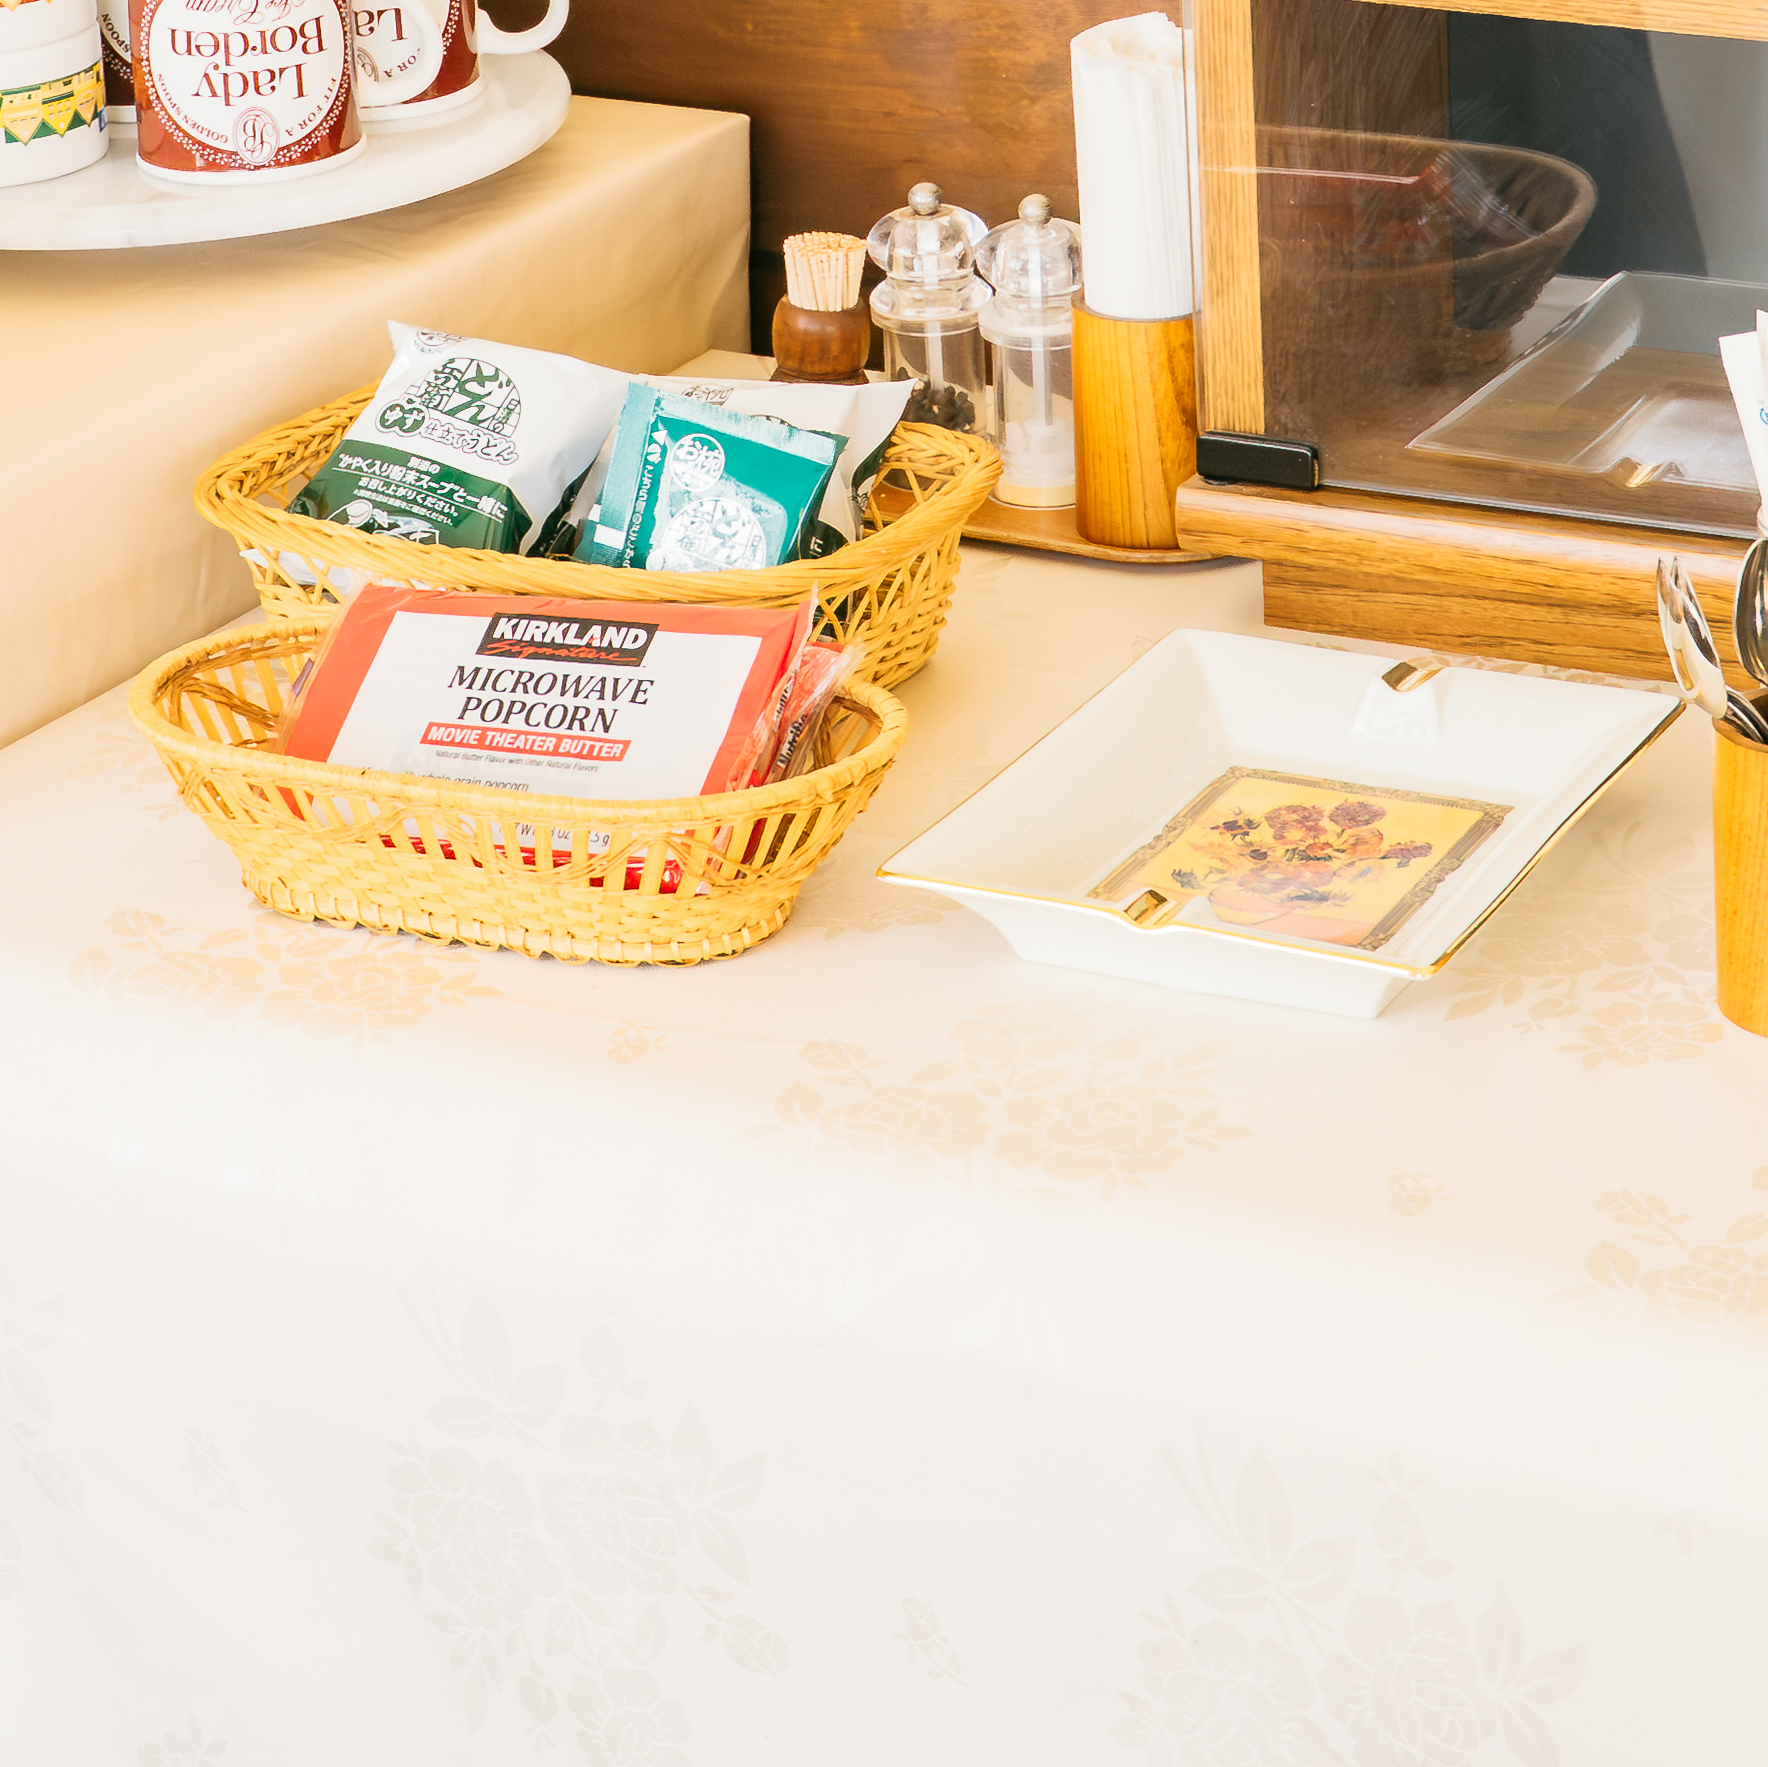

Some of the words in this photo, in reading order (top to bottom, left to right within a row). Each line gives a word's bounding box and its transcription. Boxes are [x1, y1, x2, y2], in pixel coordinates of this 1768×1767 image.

[101, 13, 131, 55] SPOON
[166, 14, 329, 67] Borden
[351, 6, 408, 43] La
[396, 48, 422, 70] OR
[156, 72, 184, 118] SPOON
[192, 62, 309, 107] Lady
[321, 76, 338, 102] FIT
[181, 113, 230, 144] GOLDEN
[284, 126, 295, 138] A
[297, 103, 324, 130] FOR
[493, 617, 649, 650] KIRKLAND
[482, 640, 639, 663] Signature
[447, 665, 655, 706] MICROWAVE
[457, 696, 620, 734] POPCORN
[427, 725, 483, 746] MOVIE
[484, 731, 556, 753] THEATER
[558, 737, 626, 758] BUTTER
[435, 749, 460, 760] Natural
[461, 751, 484, 762] Butter
[485, 754, 507, 764] Flavor
[508, 757, 524, 765] with
[524, 758, 545, 767] Other
[545, 760, 572, 770] Natural
[573, 763, 600, 773] Flavors
